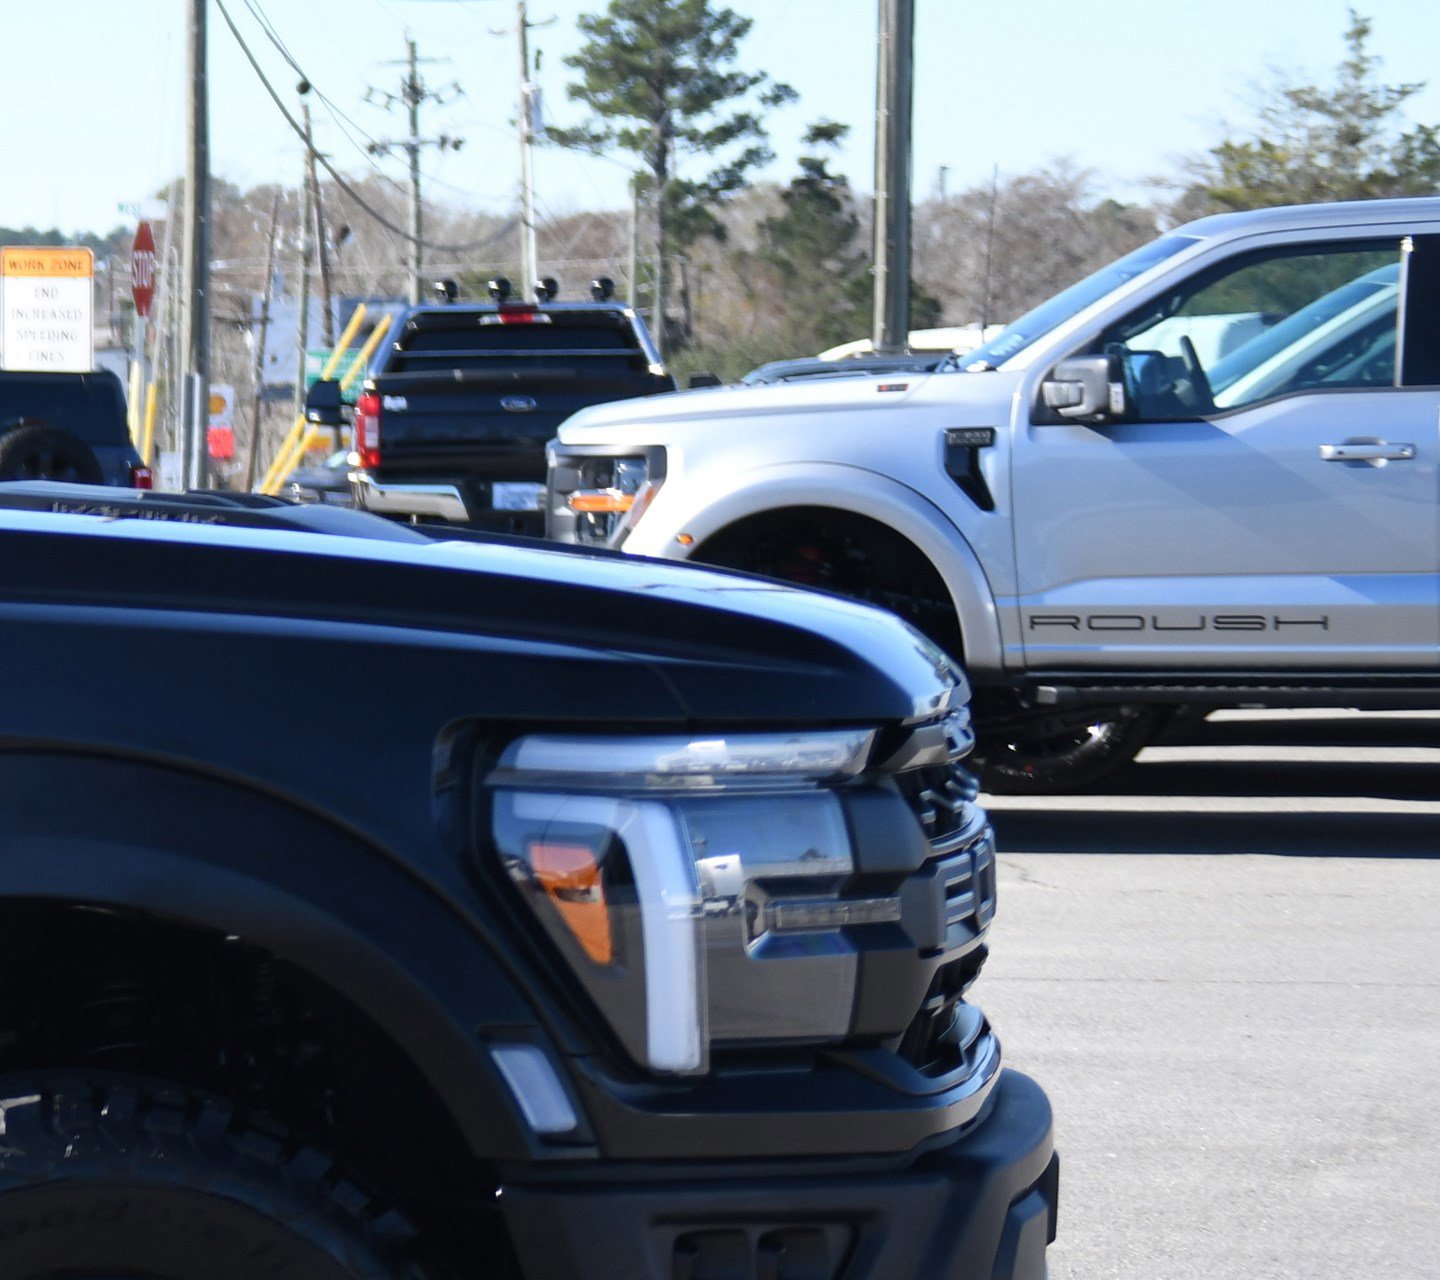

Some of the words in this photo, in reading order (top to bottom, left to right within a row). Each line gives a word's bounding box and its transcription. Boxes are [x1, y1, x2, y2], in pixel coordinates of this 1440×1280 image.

[8, 259, 45, 270] WORK
[132, 251, 155, 288] STOP
[34, 287, 58, 298] END
[11, 308, 82, 320] INCREASED
[16, 329, 79, 341] SPEEDING
[1030, 614, 1329, 631] ROUSH
